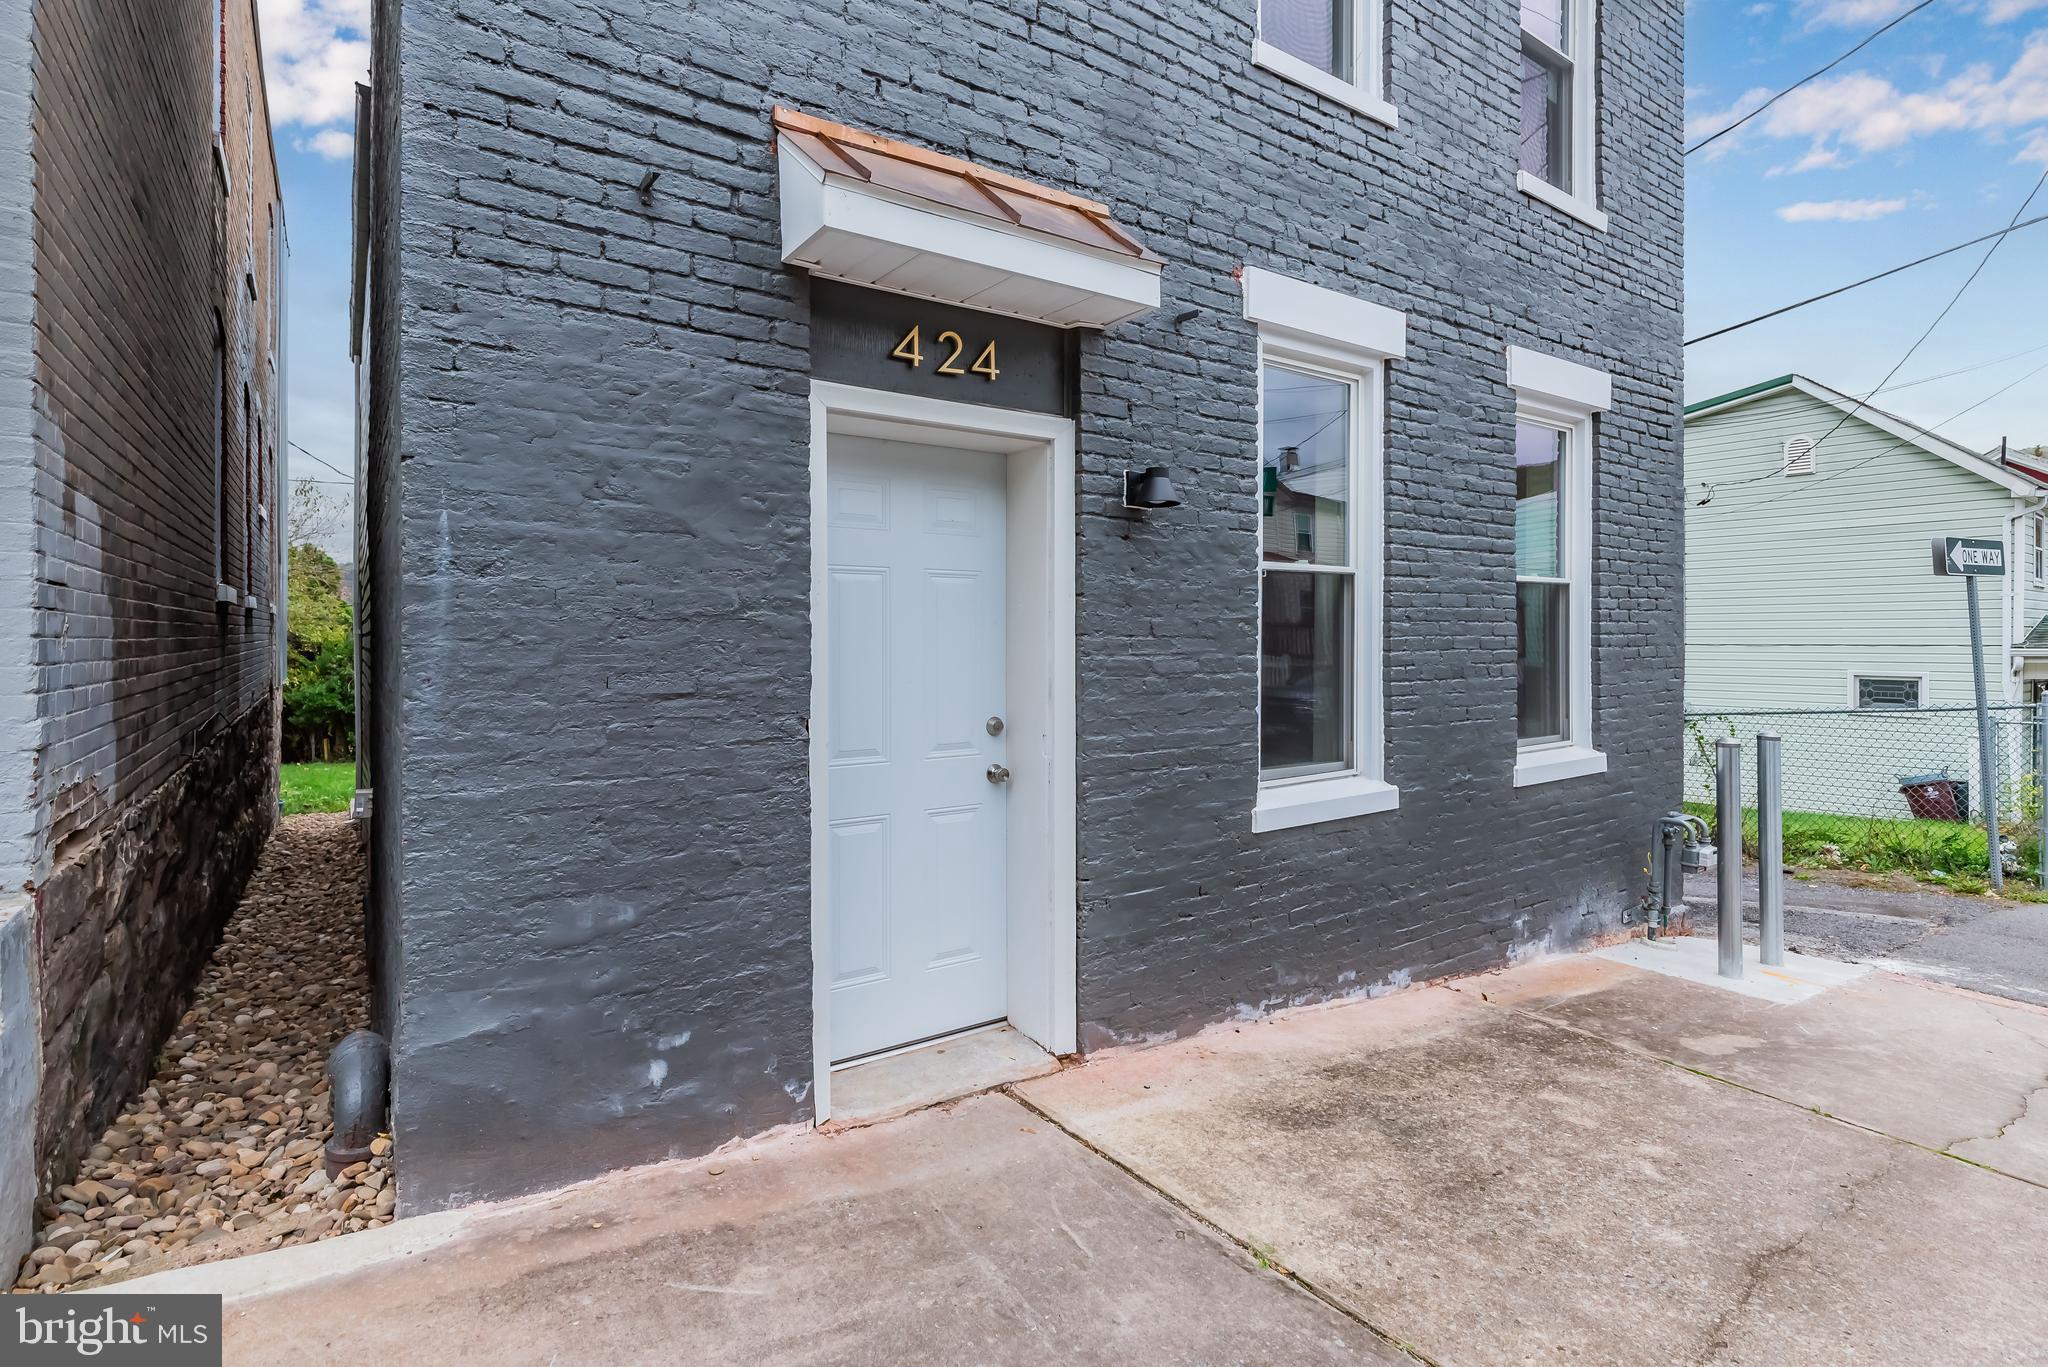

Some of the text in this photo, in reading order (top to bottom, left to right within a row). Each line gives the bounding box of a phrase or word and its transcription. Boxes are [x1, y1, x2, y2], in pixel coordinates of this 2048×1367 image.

[893, 325, 1000, 380] 424
[1963, 549, 2000, 565] ONE WAY
